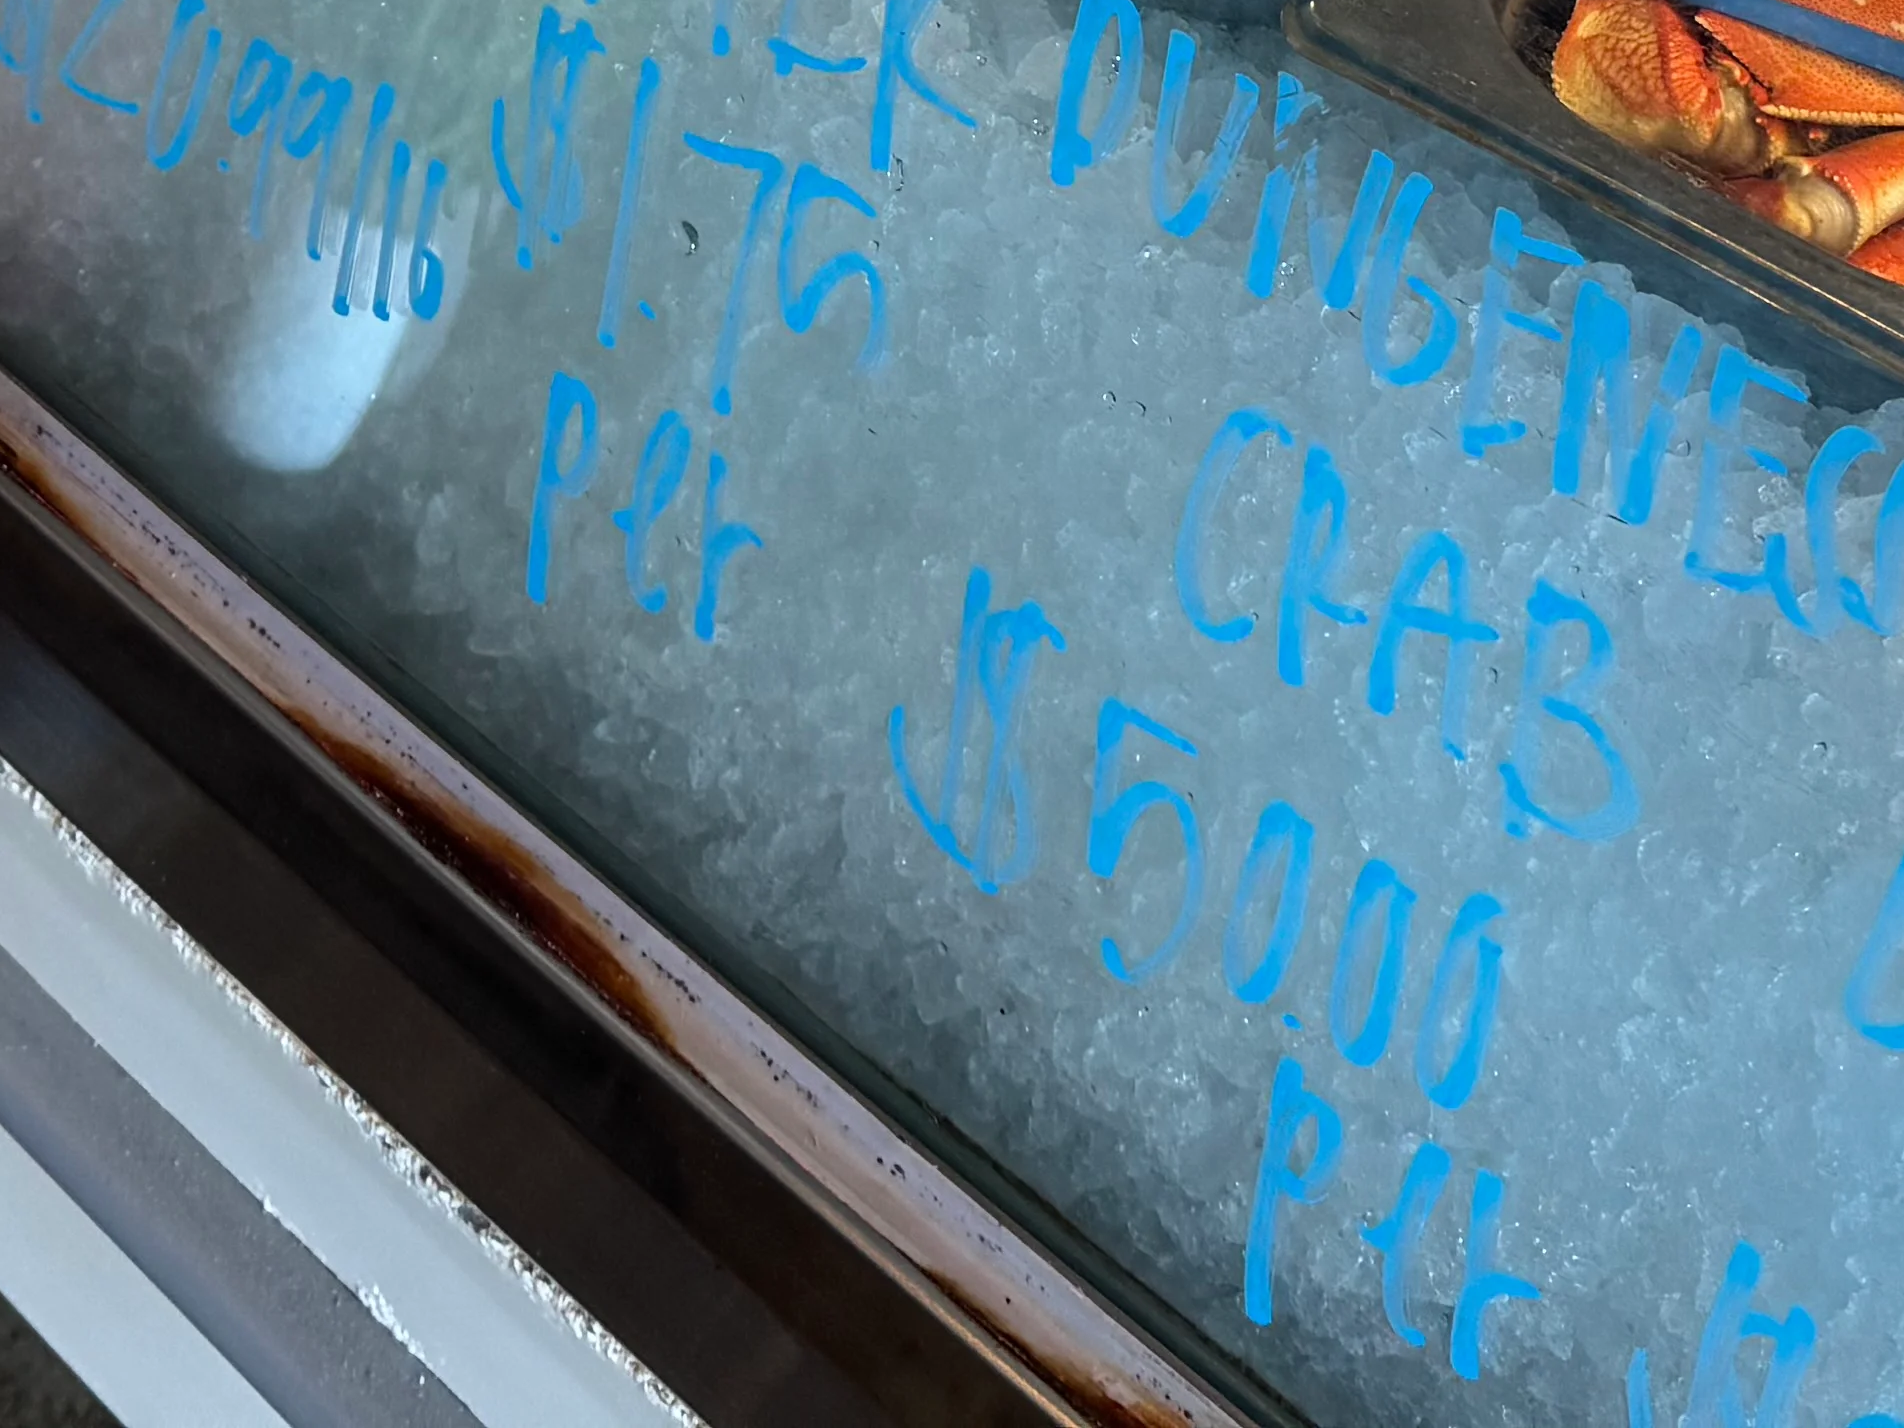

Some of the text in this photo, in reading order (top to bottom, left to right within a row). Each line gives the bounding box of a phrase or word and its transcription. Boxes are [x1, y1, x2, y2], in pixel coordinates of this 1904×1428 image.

[491, 4, 886, 416] $1.75
[888, 565, 1508, 1111] $50.00
[1173, 407, 1642, 841] CRAB
